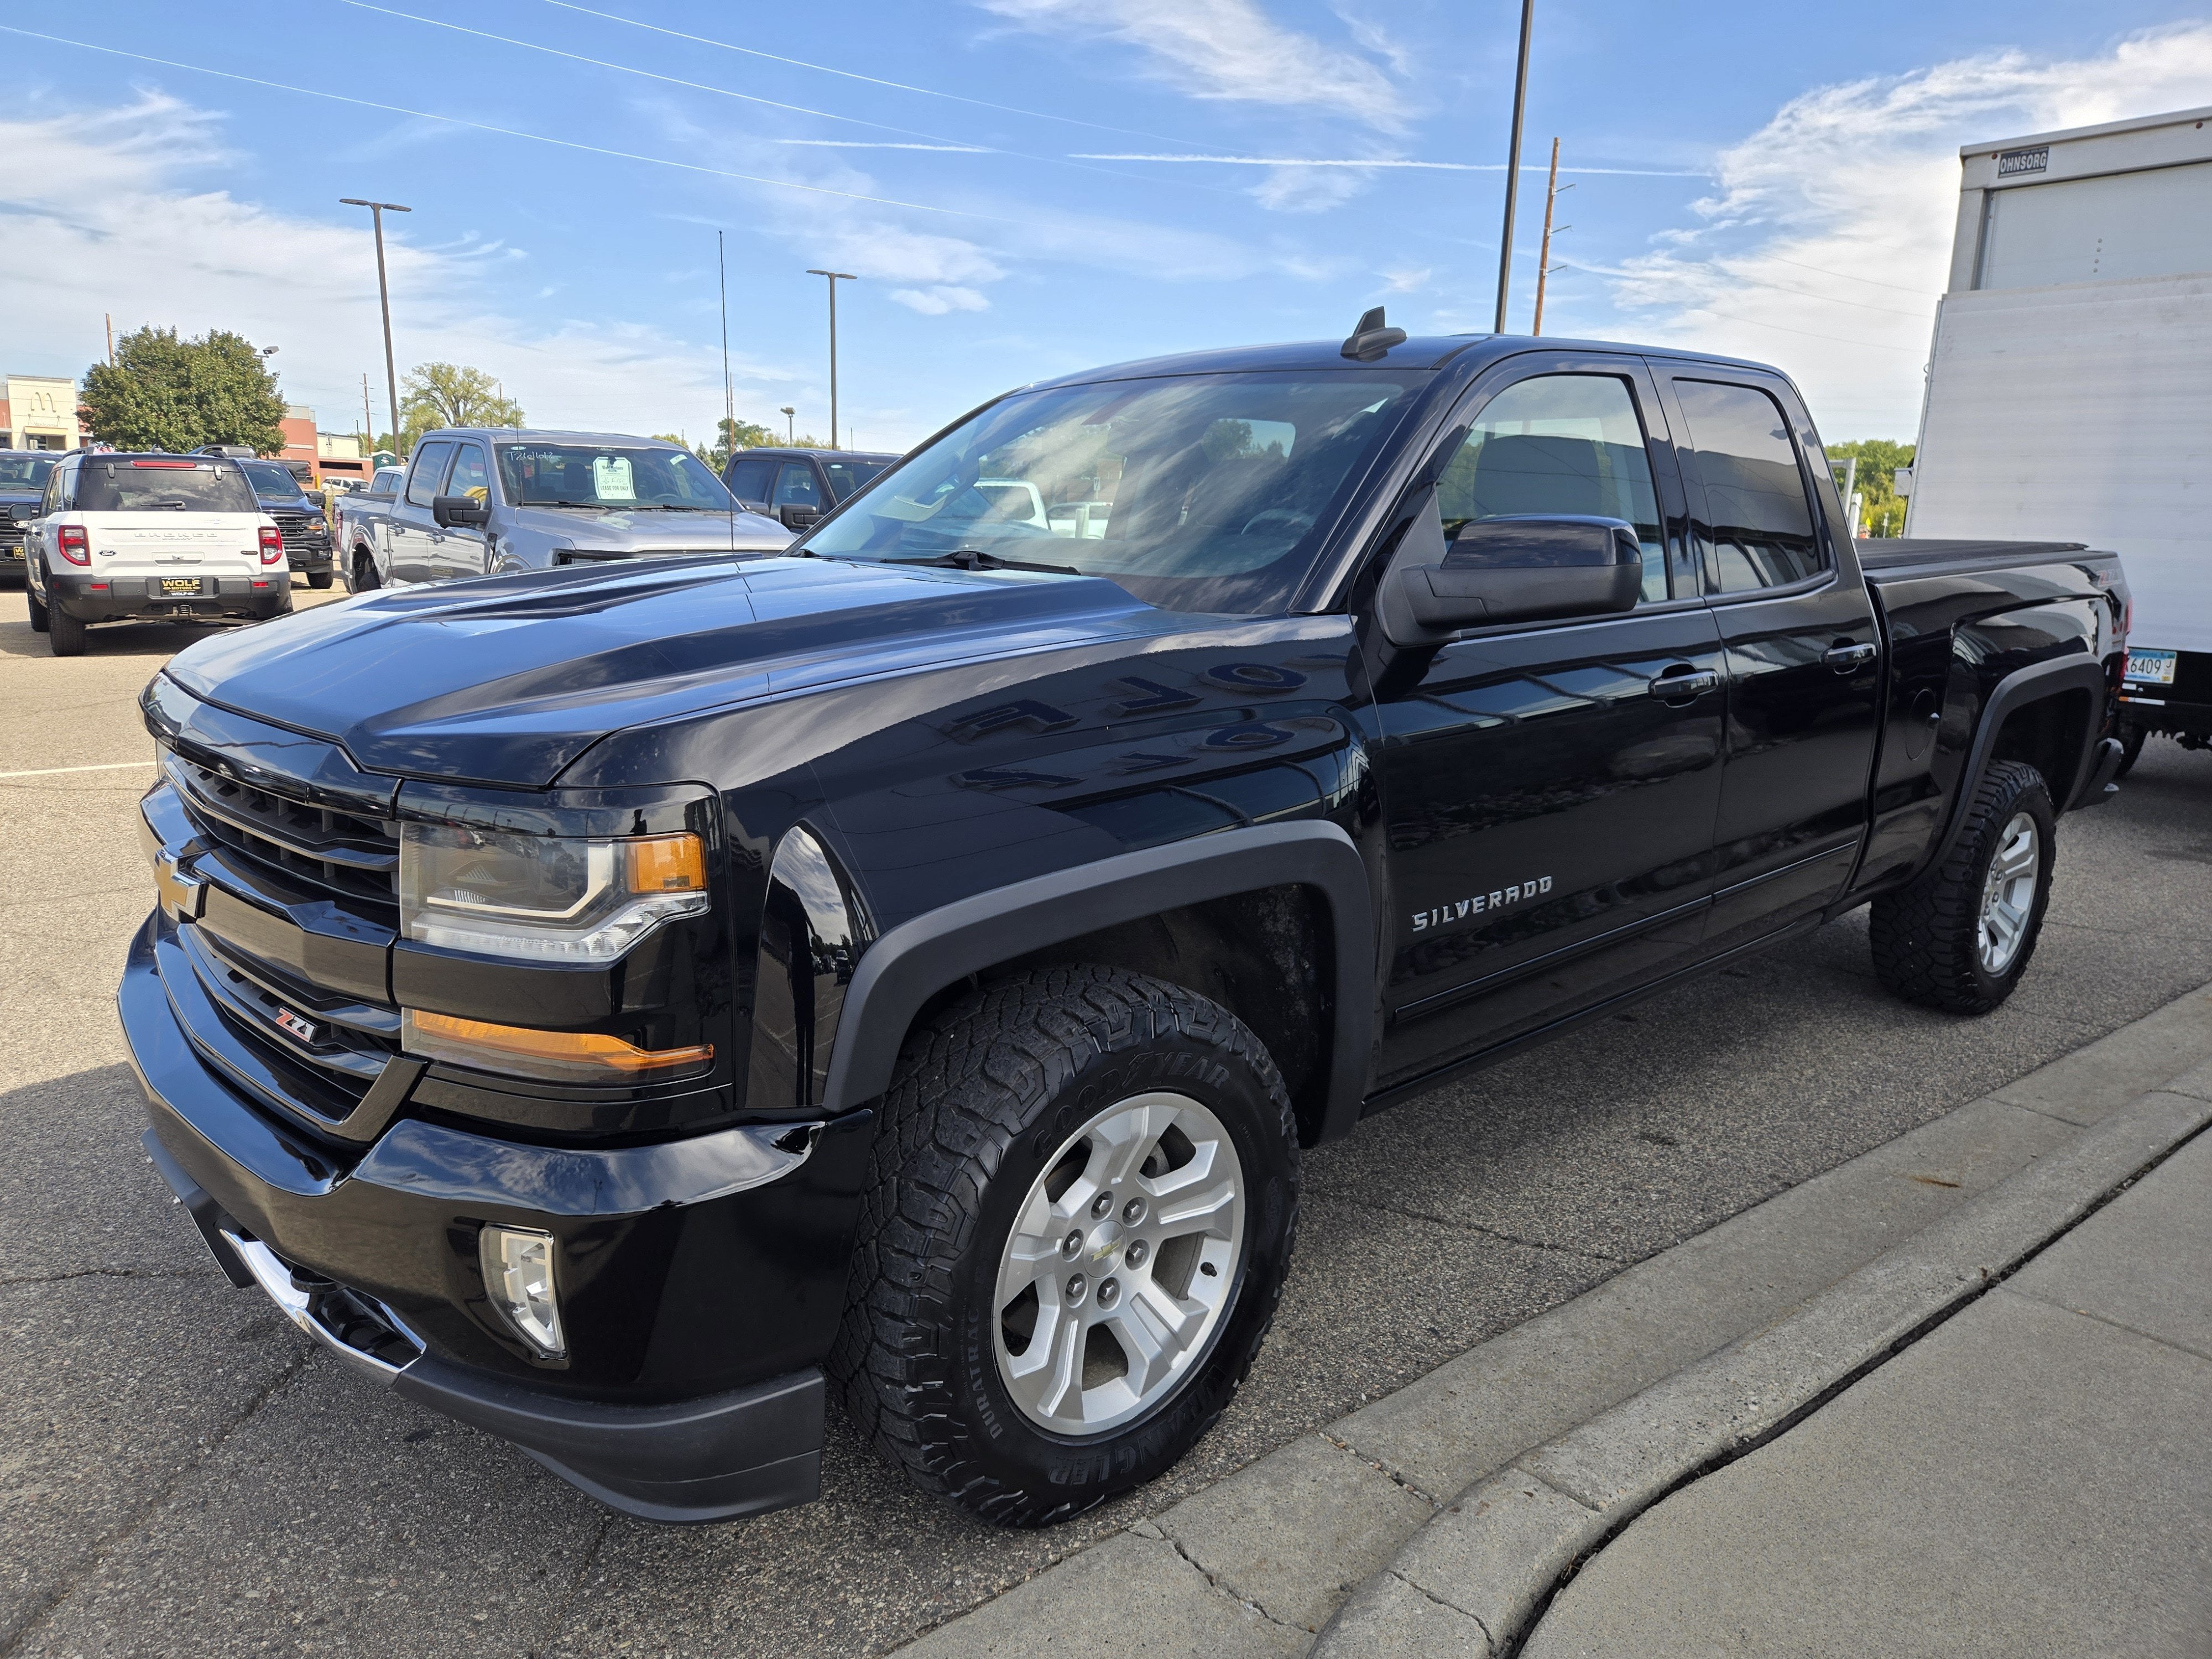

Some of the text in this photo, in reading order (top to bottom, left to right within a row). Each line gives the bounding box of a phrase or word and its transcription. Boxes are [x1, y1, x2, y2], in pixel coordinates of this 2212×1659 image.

[2000, 152, 2047, 173] OHNSORG
[1411, 875, 1553, 932] SILVERADO
[275, 1008, 315, 1042] Z71
[1032, 1051, 1230, 1160] GOODYEAR
[967, 1307, 1004, 1440] DURATRAC
[1048, 1364, 1227, 1486] WRANGLER
